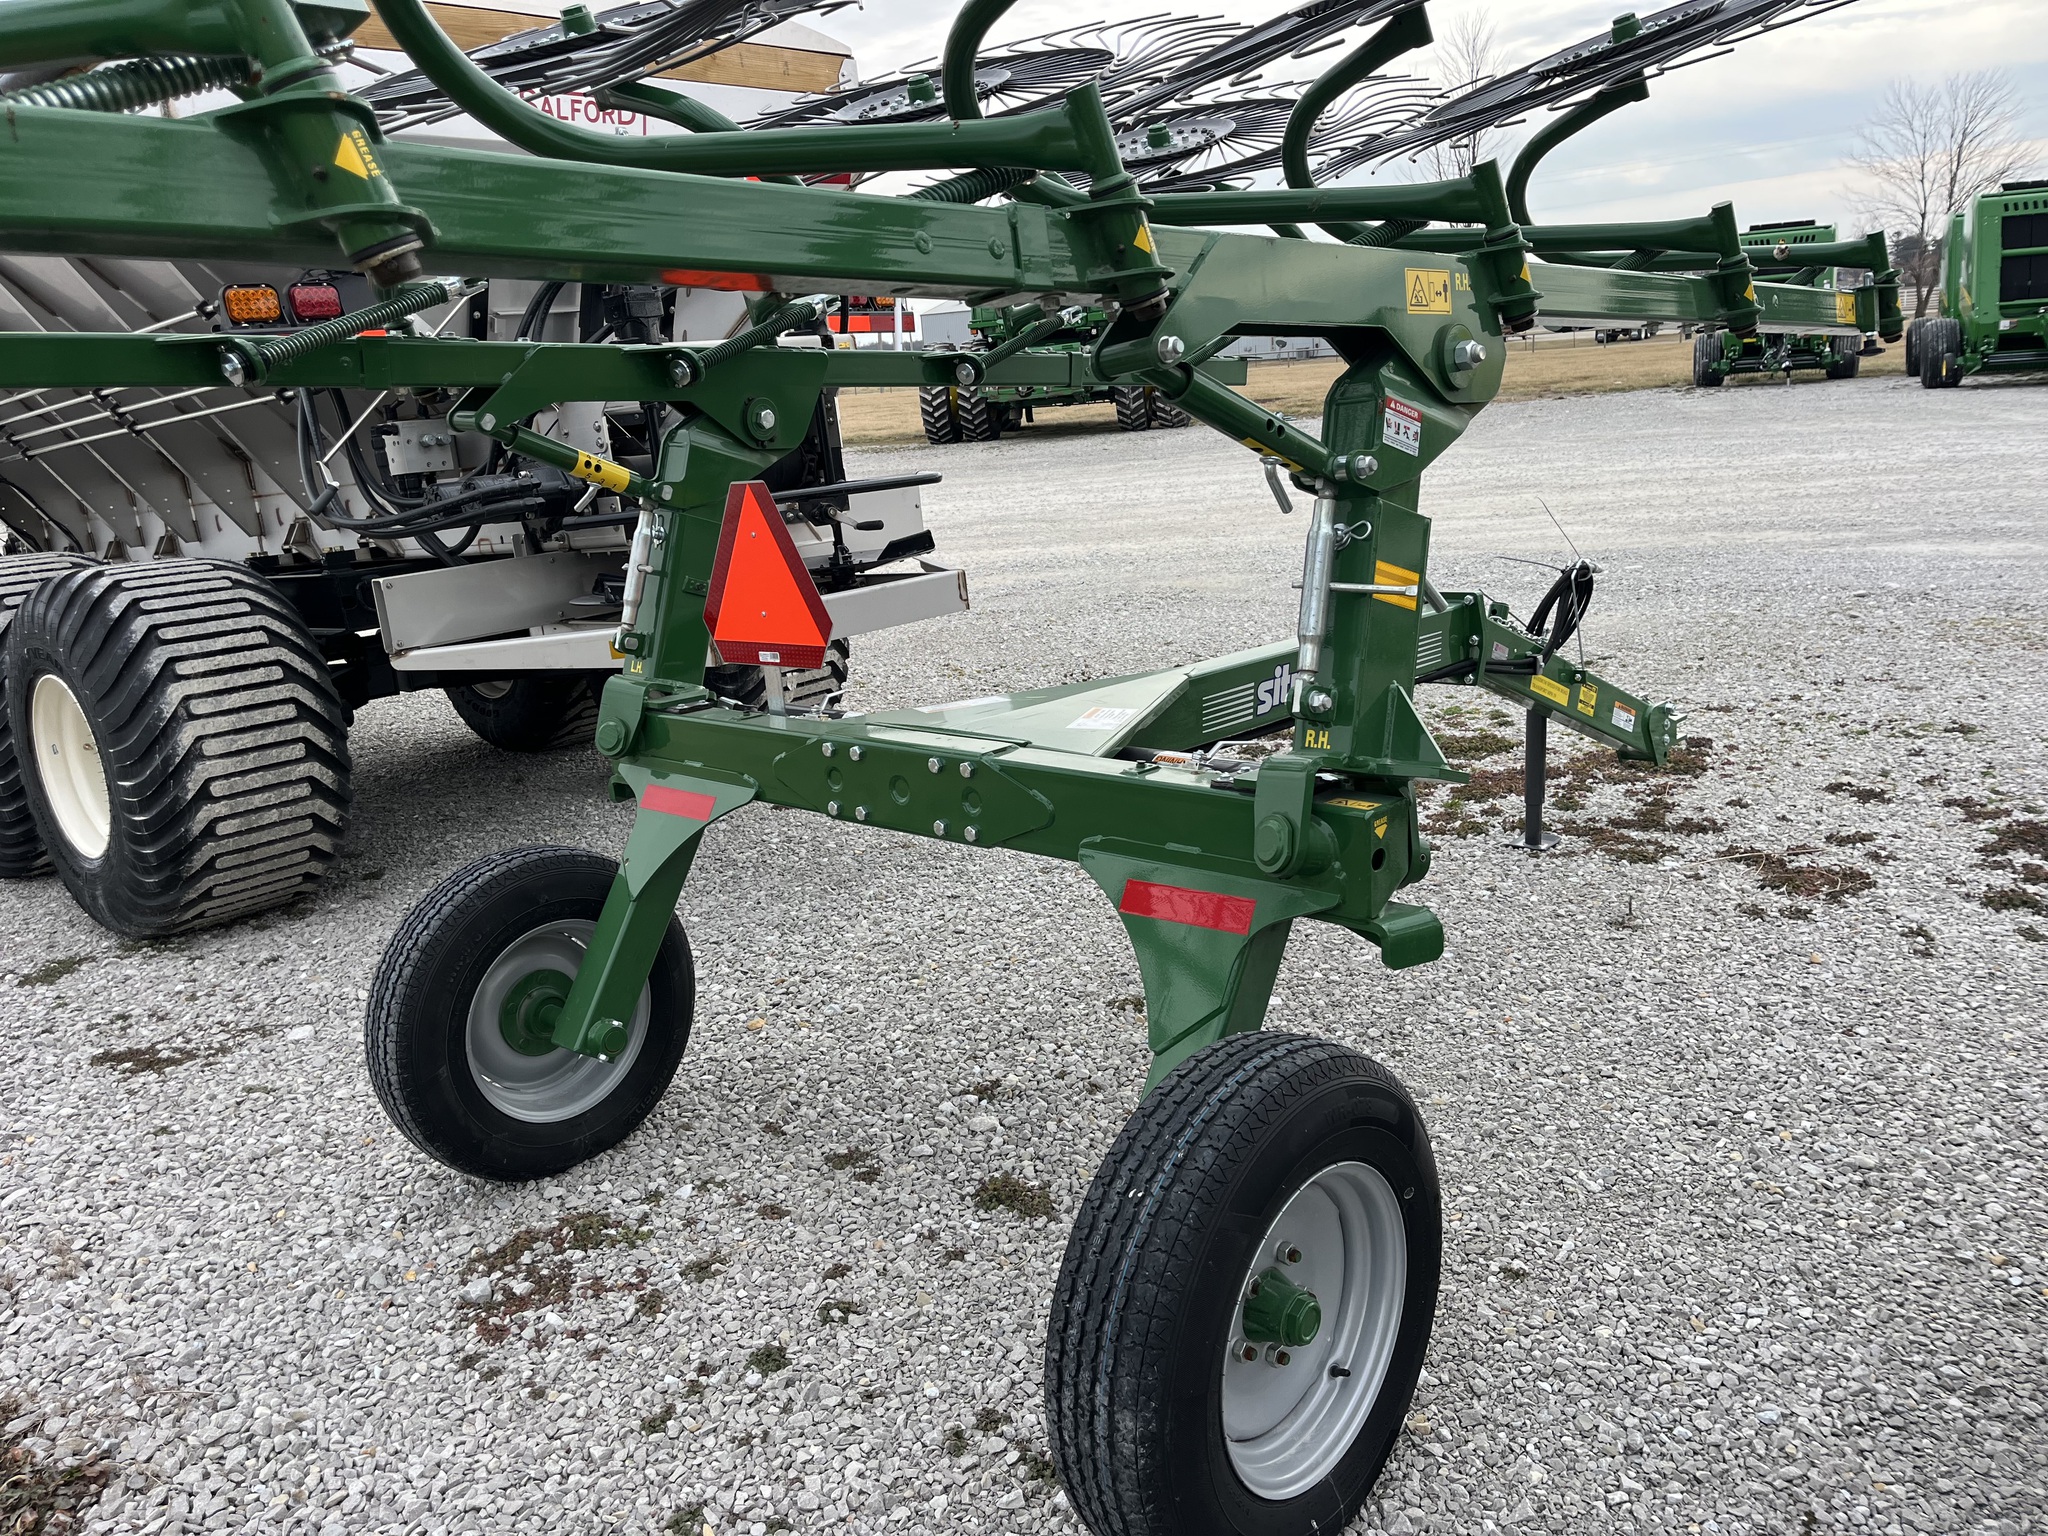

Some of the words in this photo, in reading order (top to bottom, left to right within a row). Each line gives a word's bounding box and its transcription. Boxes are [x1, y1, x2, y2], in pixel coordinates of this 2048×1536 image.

[351, 130, 381, 177] GREASE
[1396, 402, 1419, 419] DANGER
[630, 659, 643, 674] L.H.
[1305, 729, 1331, 749] R.H.
